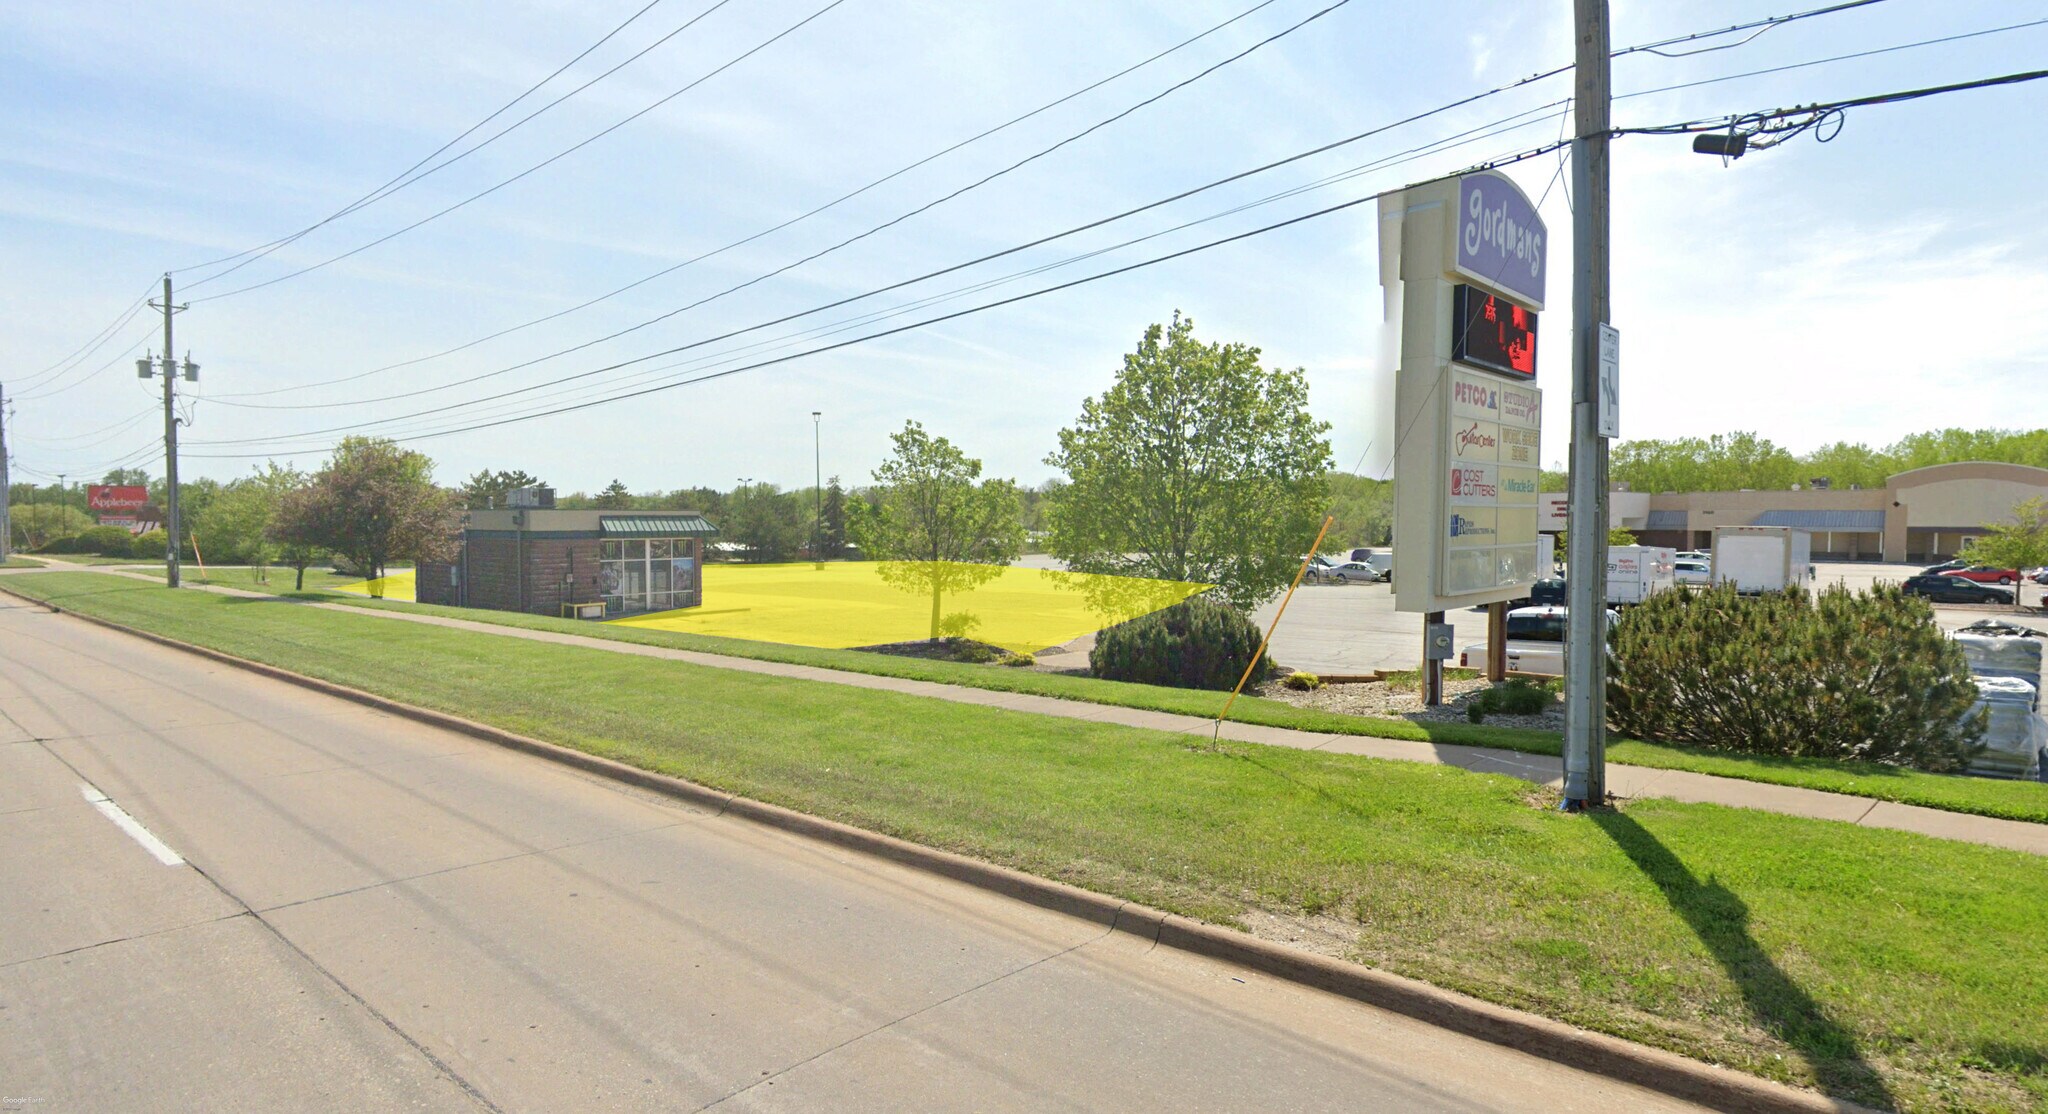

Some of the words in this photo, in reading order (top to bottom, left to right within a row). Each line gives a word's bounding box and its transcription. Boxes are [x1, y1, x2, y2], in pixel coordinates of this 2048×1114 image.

[1465, 189, 1540, 277] gordmans
[1455, 382, 1487, 407] PETCO
[1503, 391, 1529, 408] STUDIO
[1463, 469, 1484, 482] COST
[1463, 483, 1496, 497] CUTTERS
